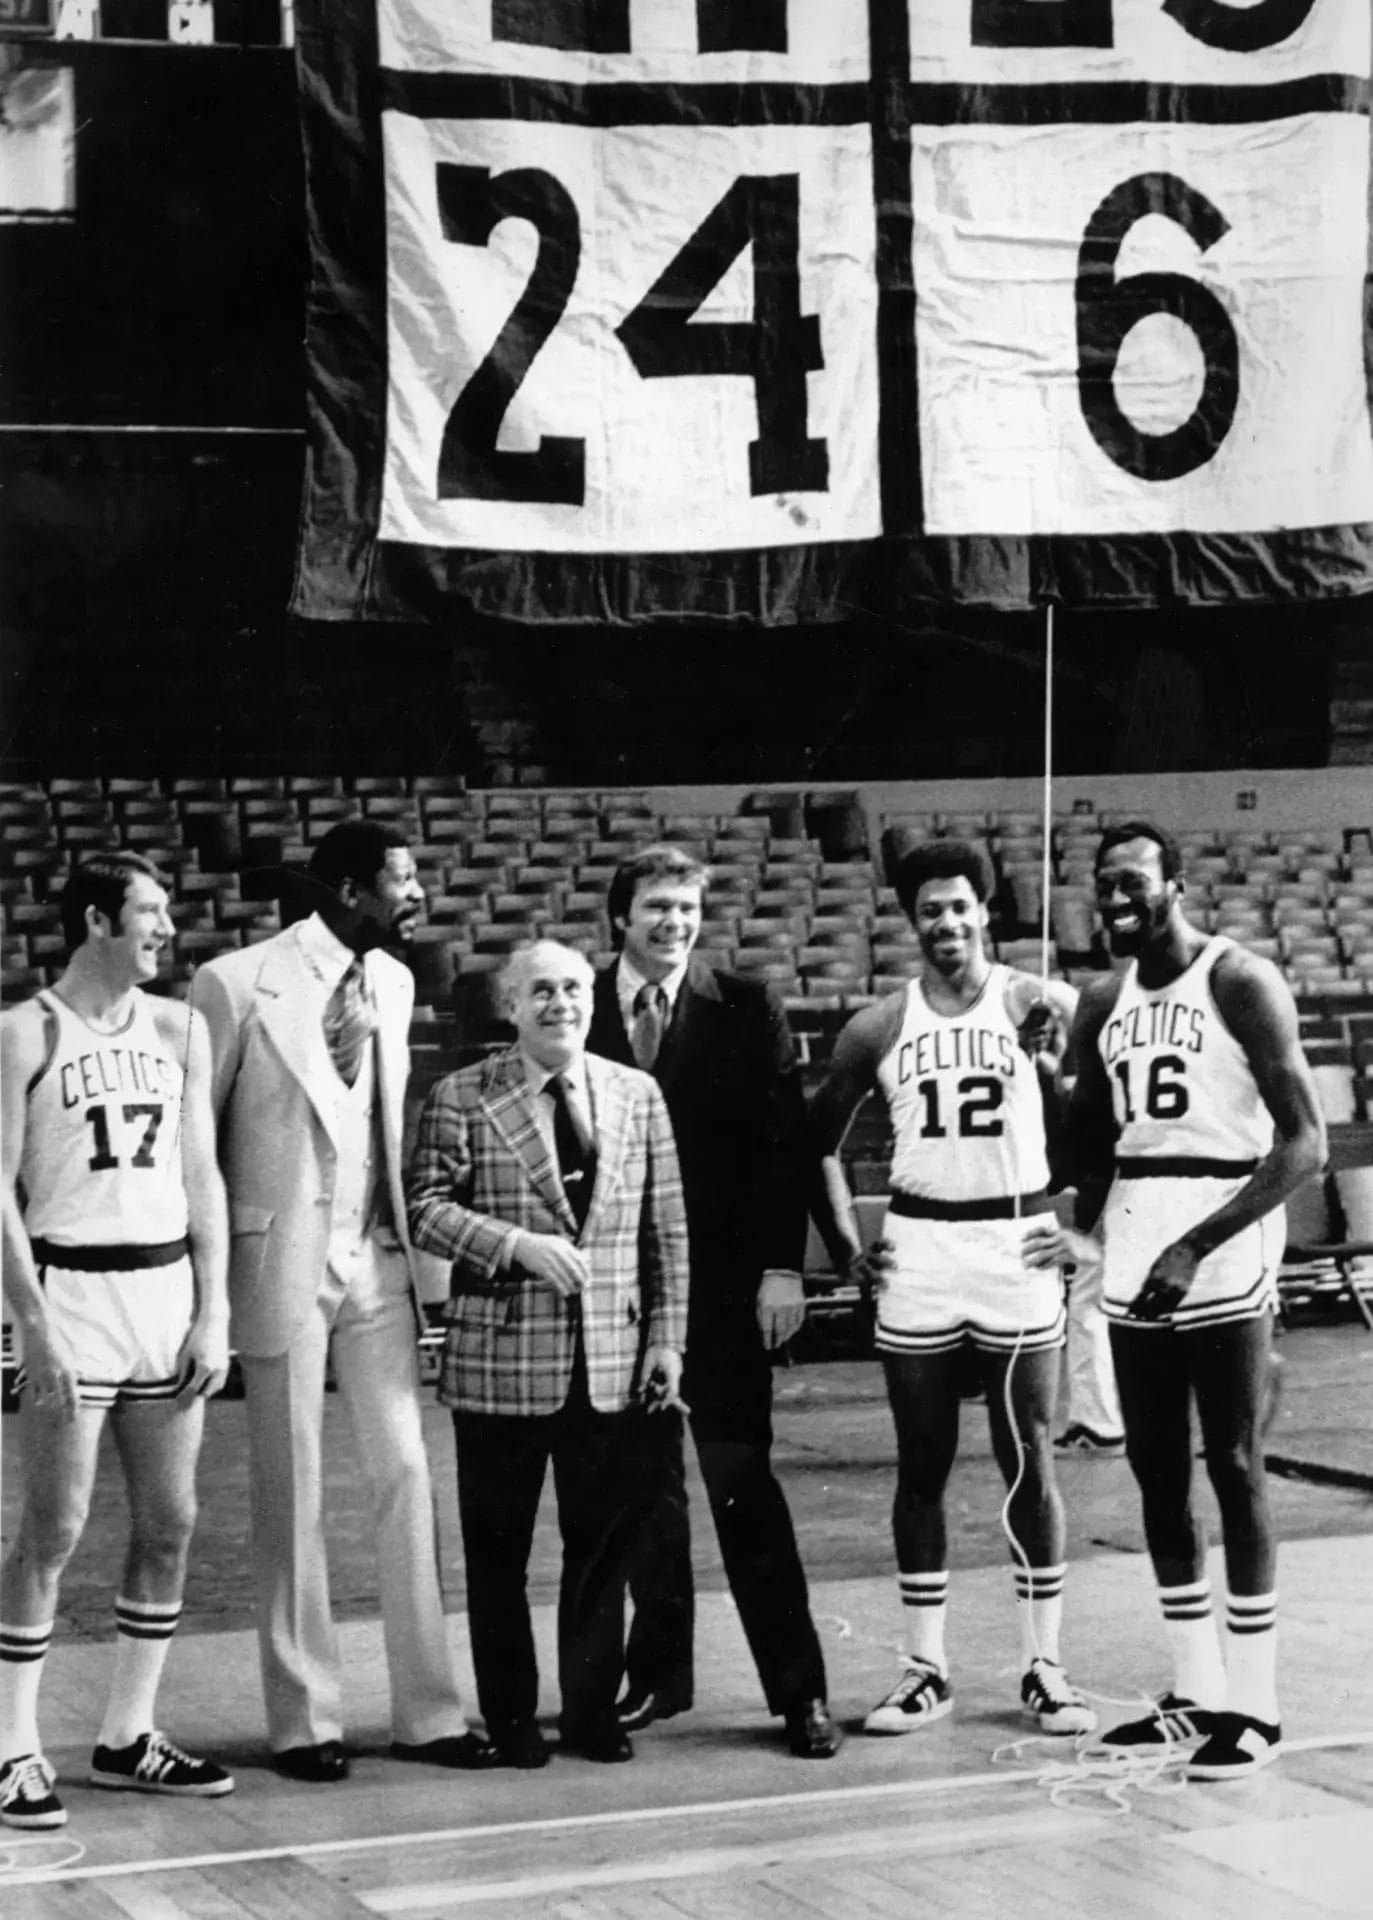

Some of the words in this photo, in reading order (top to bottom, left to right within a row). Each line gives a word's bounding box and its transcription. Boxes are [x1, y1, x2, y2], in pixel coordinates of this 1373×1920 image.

[436, 162, 829, 506] 24
[1075, 171, 1240, 481] 6
[898, 1027, 1016, 1086] CELTICS
[1106, 1000, 1205, 1064] CELTICS
[918, 1076, 1004, 1138] 12
[1115, 1054, 1189, 1123] 16
[85, 1103, 164, 1172] 17
